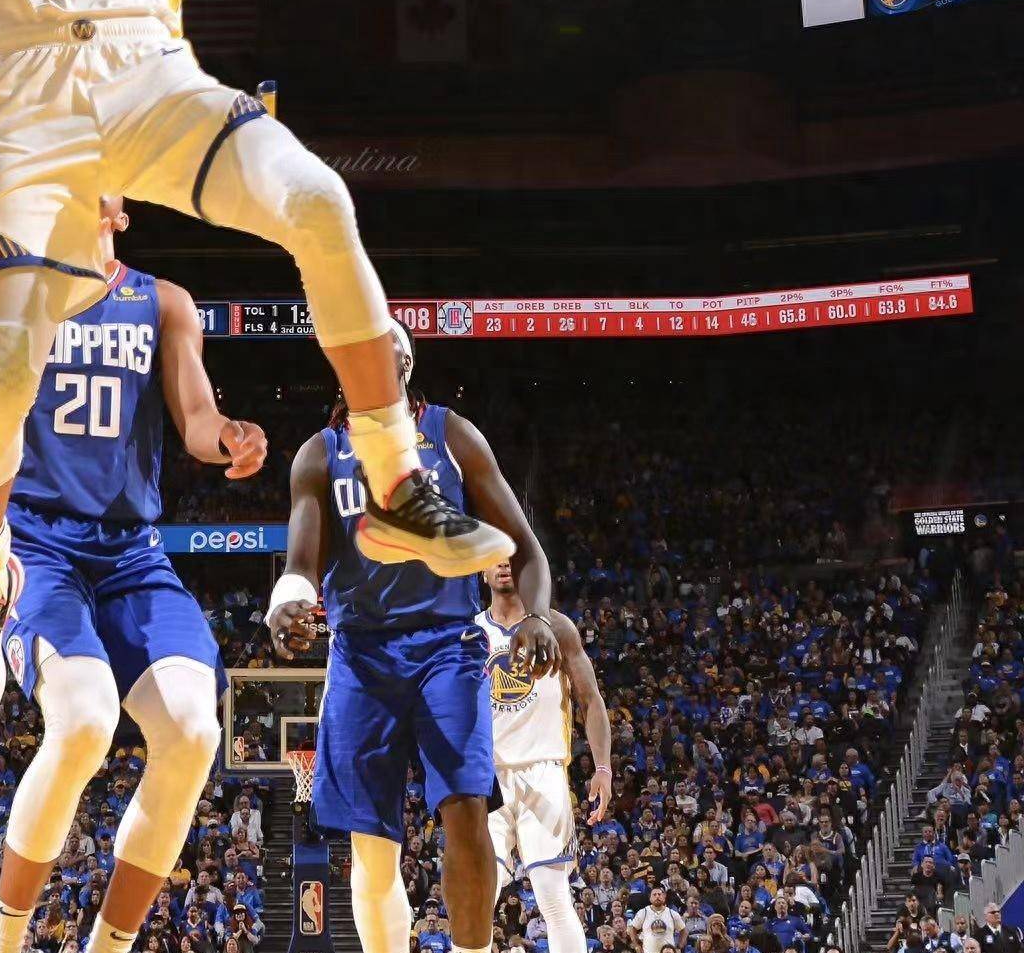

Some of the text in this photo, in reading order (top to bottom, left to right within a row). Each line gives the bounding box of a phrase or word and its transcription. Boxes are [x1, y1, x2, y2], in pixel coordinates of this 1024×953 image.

[516, 302, 545, 310] OREB
[553, 302, 581, 310] DREB
[594, 302, 613, 310] STL
[629, 302, 649, 310] BLK
[669, 301, 684, 309] TO
[702, 300, 723, 309] POT
[736, 297, 760, 306] PITP
[780, 293, 804, 302] 2P%
[830, 288, 853, 298] 3P%
[879, 284, 903, 293] FG%
[930, 279, 953, 289] FT%
[244, 307, 265, 315] TOL
[394, 309, 430, 330] 108
[486, 318, 502, 332] 23
[526, 318, 535, 331] 2
[599, 317, 607, 331] 7
[634, 317, 644, 330] 4
[669, 316, 684, 330] 12
[705, 315, 719, 330] 14
[779, 308, 806, 324] 65.8
[828, 304, 856, 319] 60.0
[878, 299, 906, 315] 63.8
[928, 295, 957, 310] 84.6
[244, 321, 277, 333] FLS 4
[54, 372, 122, 438] 20
[914, 514, 964, 525] GOLDEN STATE
[915, 523, 965, 535] WARRIORS
[190, 527, 265, 552] pepsi
[491, 689, 538, 712] ARRIORS
